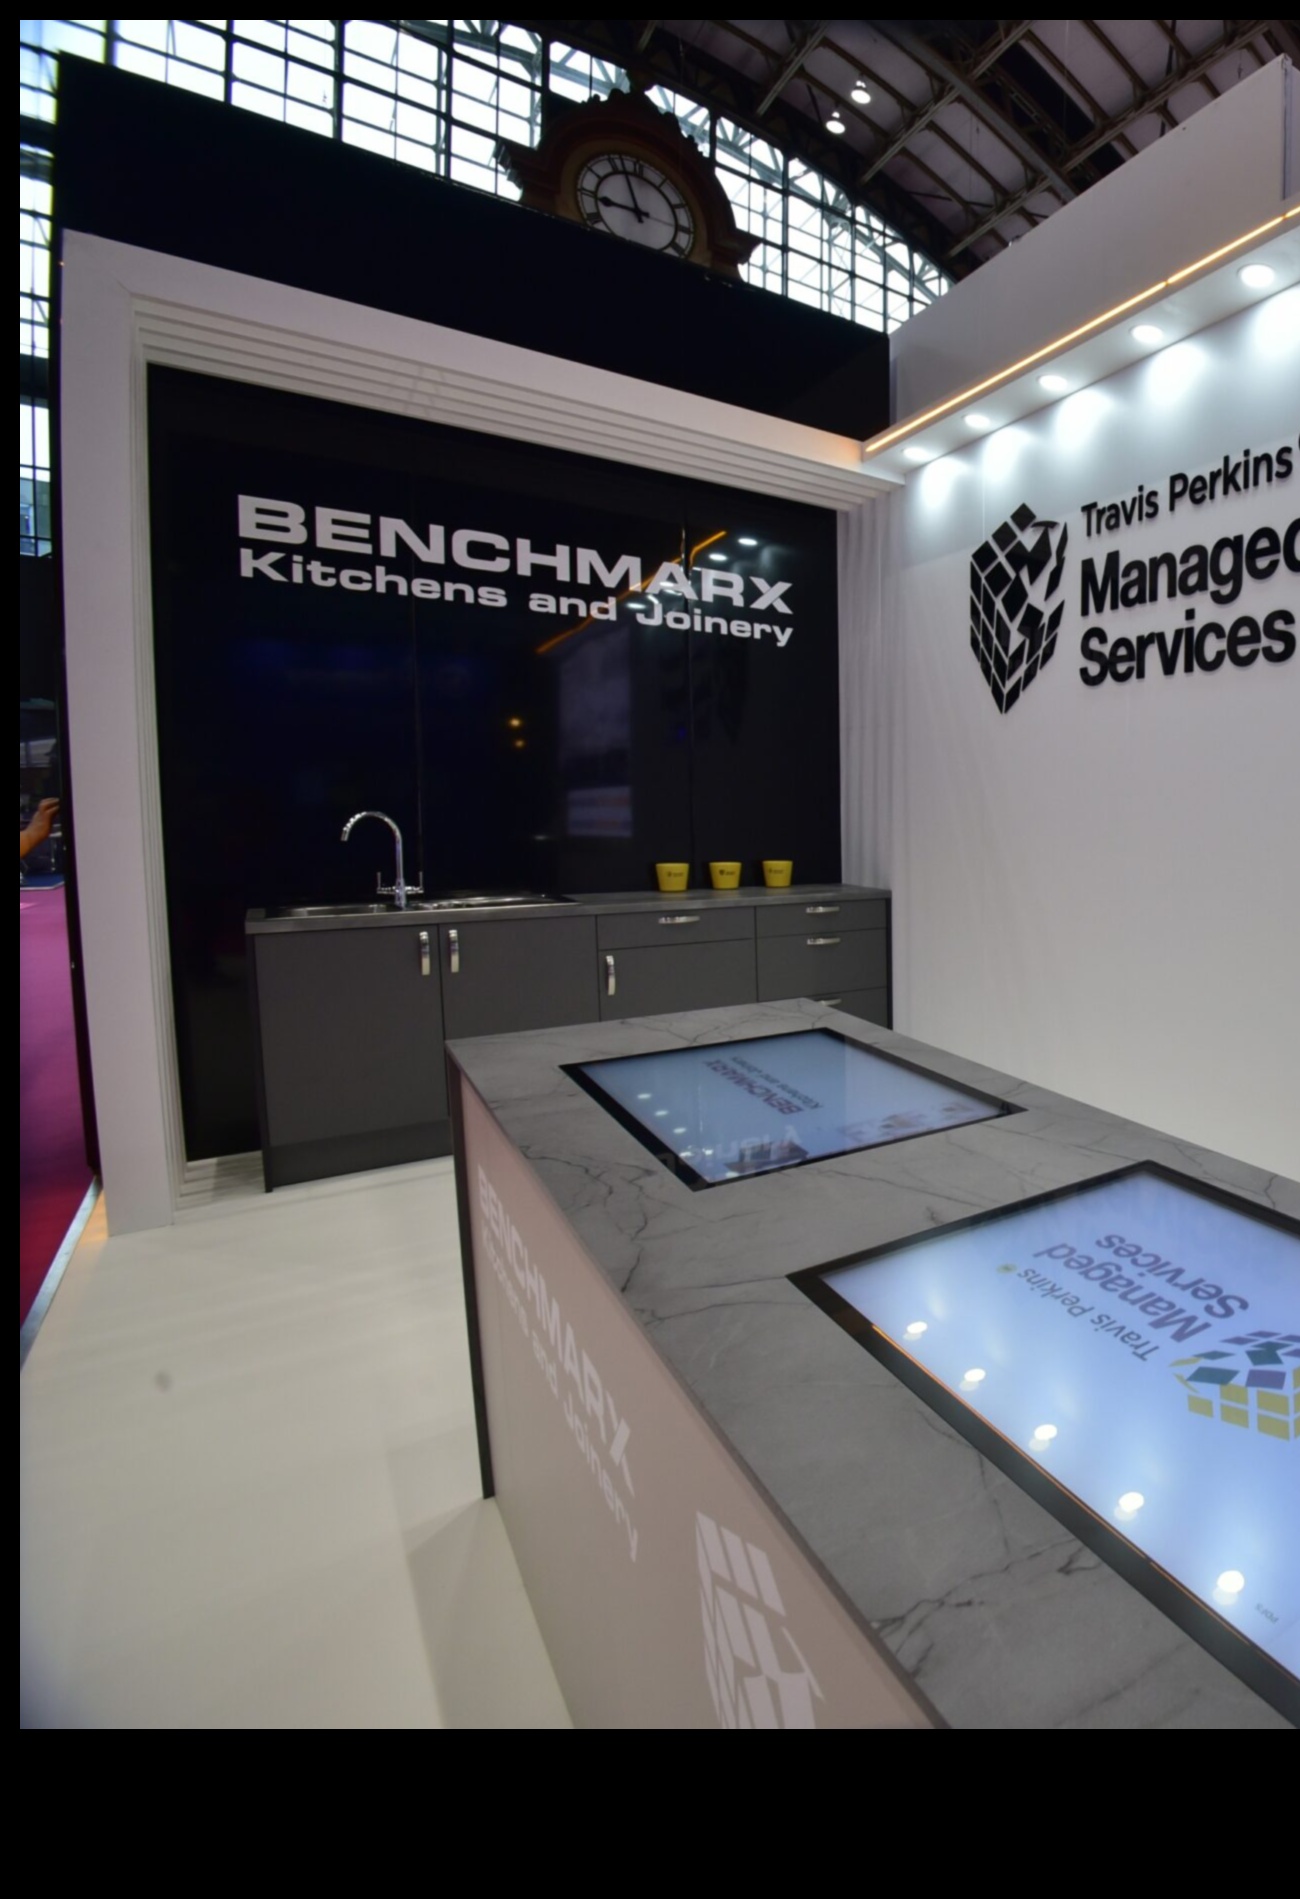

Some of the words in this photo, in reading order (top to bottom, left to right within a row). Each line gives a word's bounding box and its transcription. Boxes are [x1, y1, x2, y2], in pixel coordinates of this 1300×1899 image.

[1081, 485, 1159, 538] Travis
[1169, 446, 1293, 512] Perkins
[238, 495, 794, 614] BENCHMARX
[239, 547, 508, 607] Kitchens
[529, 592, 618, 621] and
[636, 604, 794, 647] Joinery
[1079, 608, 1297, 687] Services
[1016, 1266, 1095, 1319] Perkins
[1033, 1242, 1212, 1344] Managed
[1095, 1232, 1250, 1321] Services
[477, 1163, 635, 1497] BENCHMARX
[1090, 1312, 1160, 1362] Travis
[562, 1392, 639, 1563] Joinery
